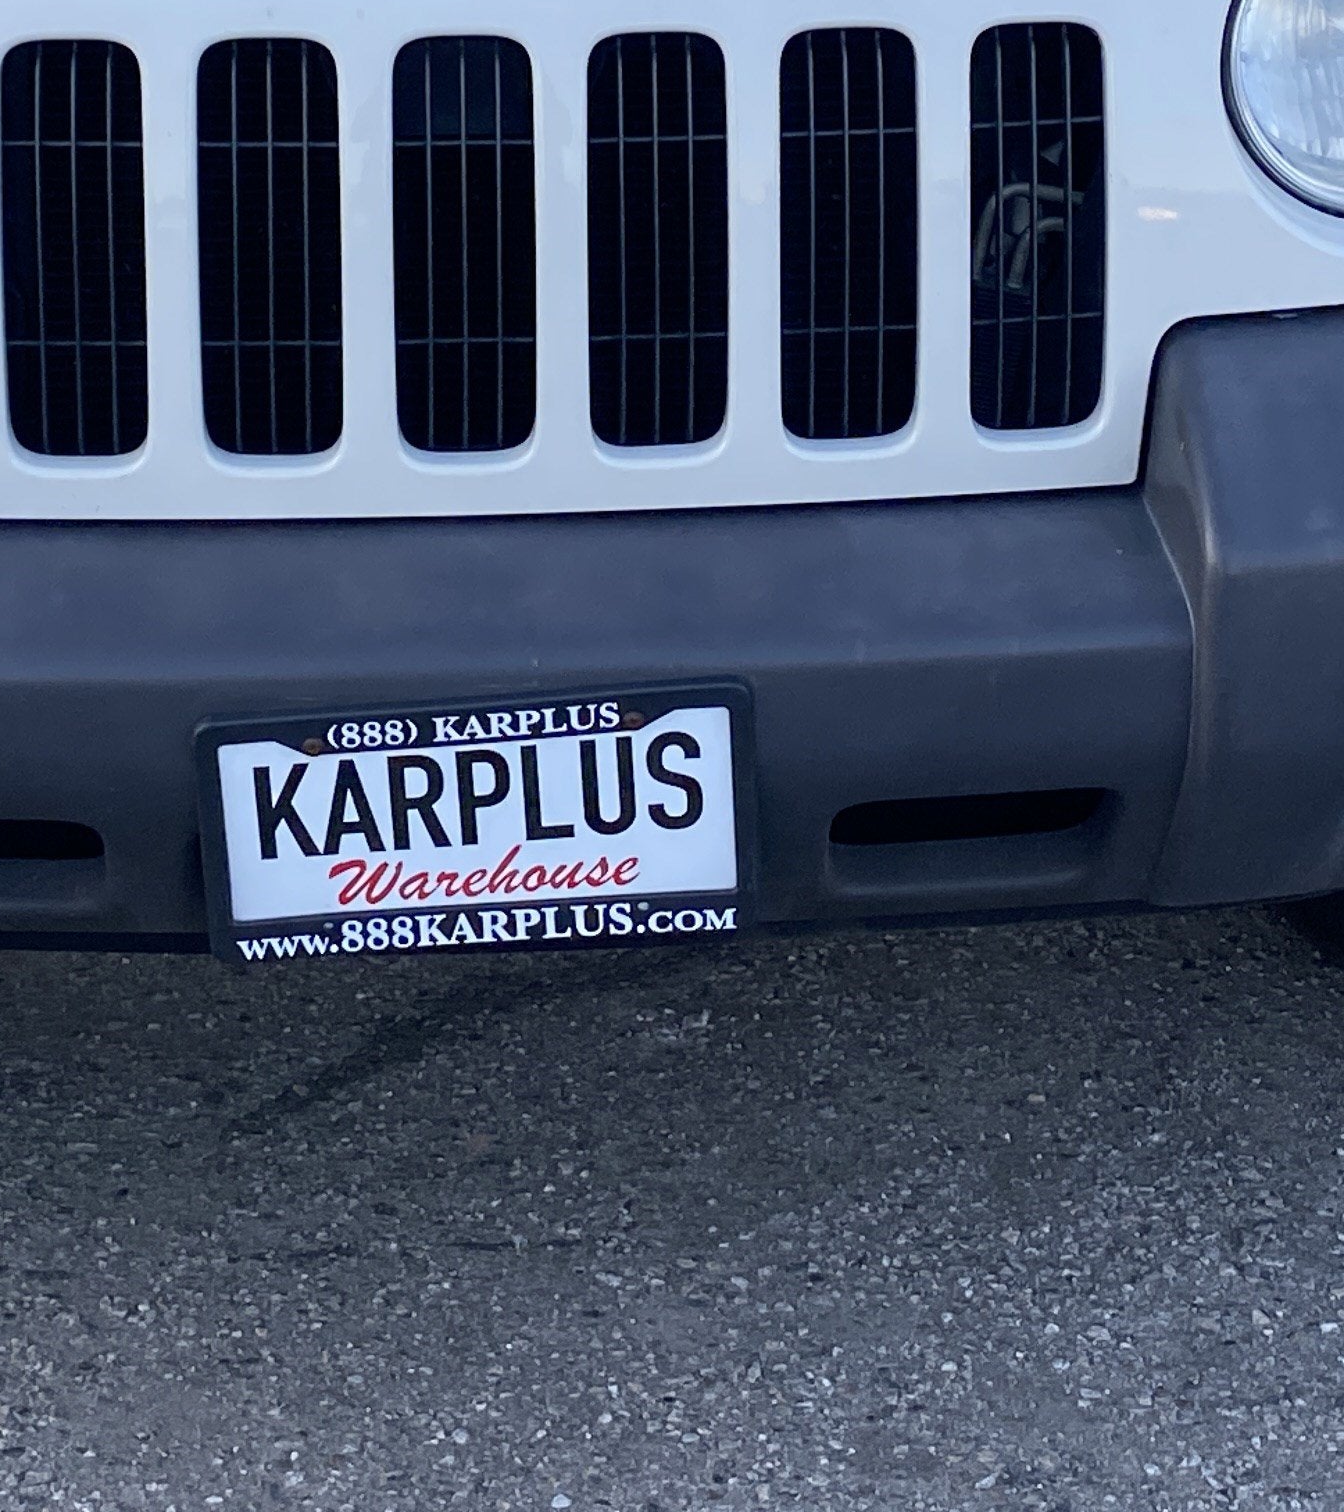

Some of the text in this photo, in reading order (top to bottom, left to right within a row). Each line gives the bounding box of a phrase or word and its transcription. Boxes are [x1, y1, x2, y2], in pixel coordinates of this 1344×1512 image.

[326, 702, 620, 749] (888) KARPLUS
[253, 731, 704, 860] KARPLUS
[328, 844, 640, 906] Warehouse
